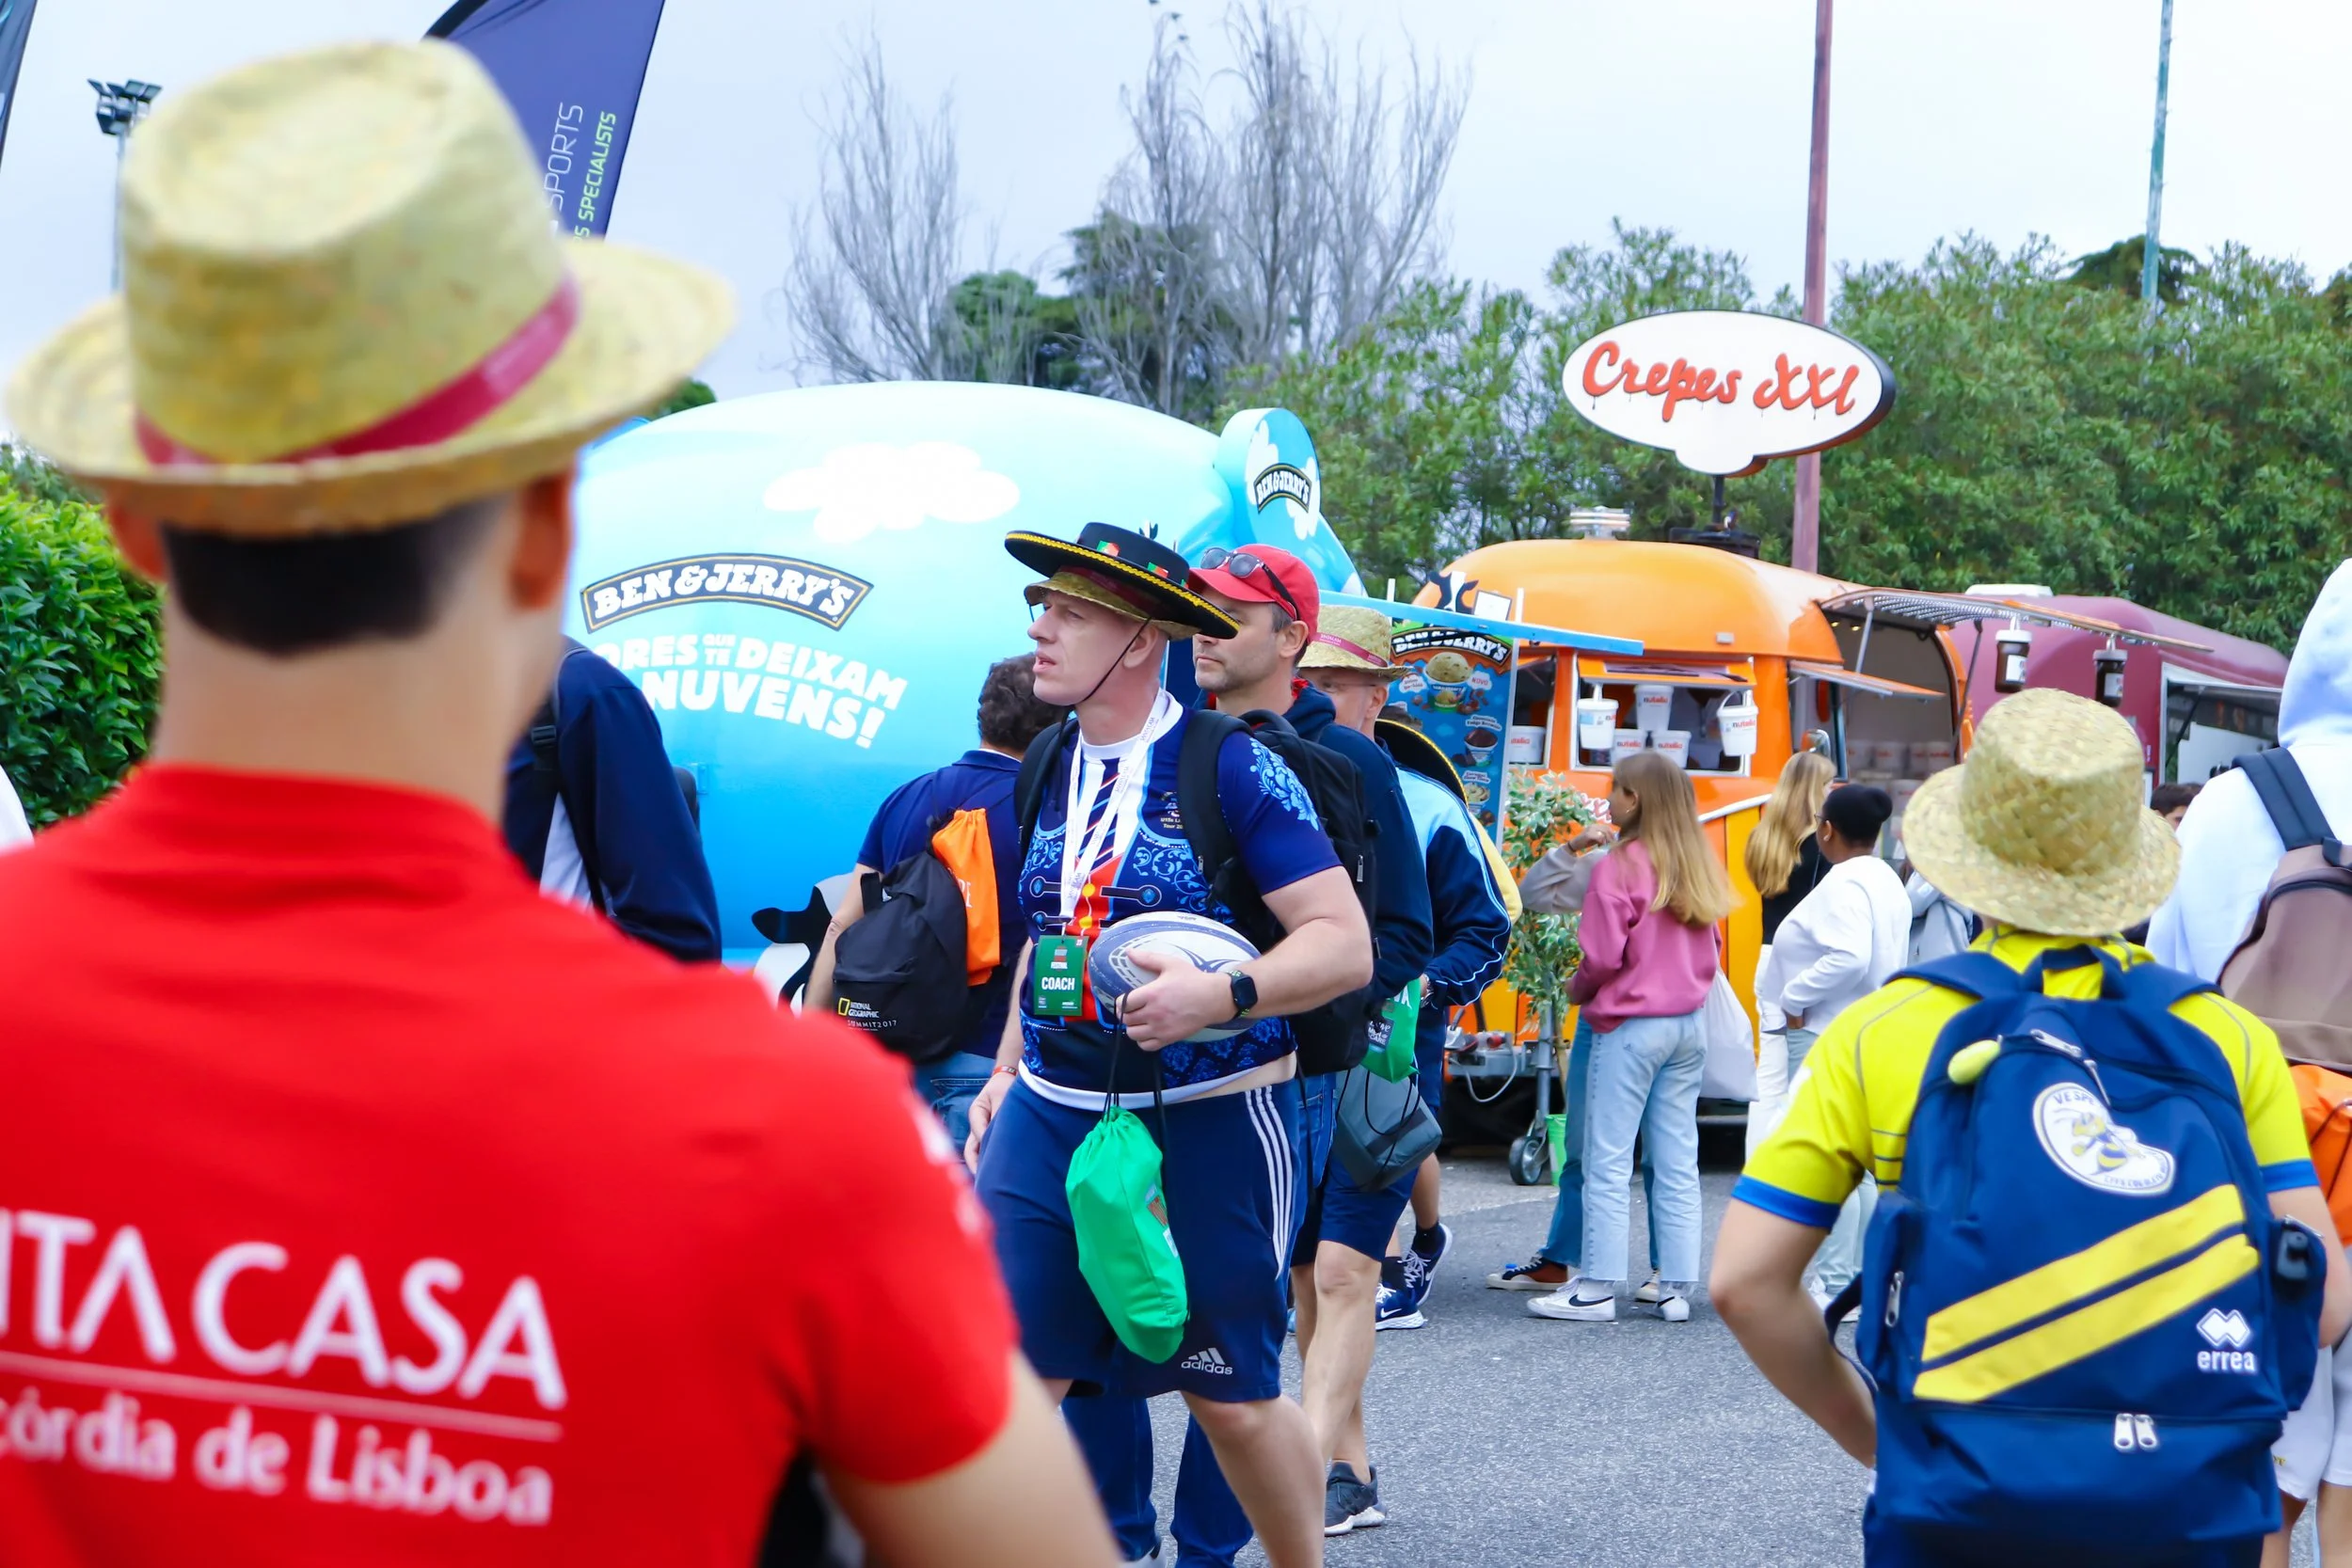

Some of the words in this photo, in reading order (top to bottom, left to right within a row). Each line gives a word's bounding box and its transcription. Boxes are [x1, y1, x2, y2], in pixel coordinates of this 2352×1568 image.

[544, 102, 583, 213] SPORTS
[578, 110, 616, 222] SPECIALISTS
[1581, 340, 1742, 422] Crepes
[642, 669, 885, 749] NUVENS!
[735, 637, 909, 711] DEIXAM
[1041, 976, 1075, 990] COACH
[193, 1241, 566, 1410] CASA
[1181, 1359, 1233, 1375] adidas
[195, 1405, 288, 1496] de
[307, 1414, 553, 1526] Lisboa
